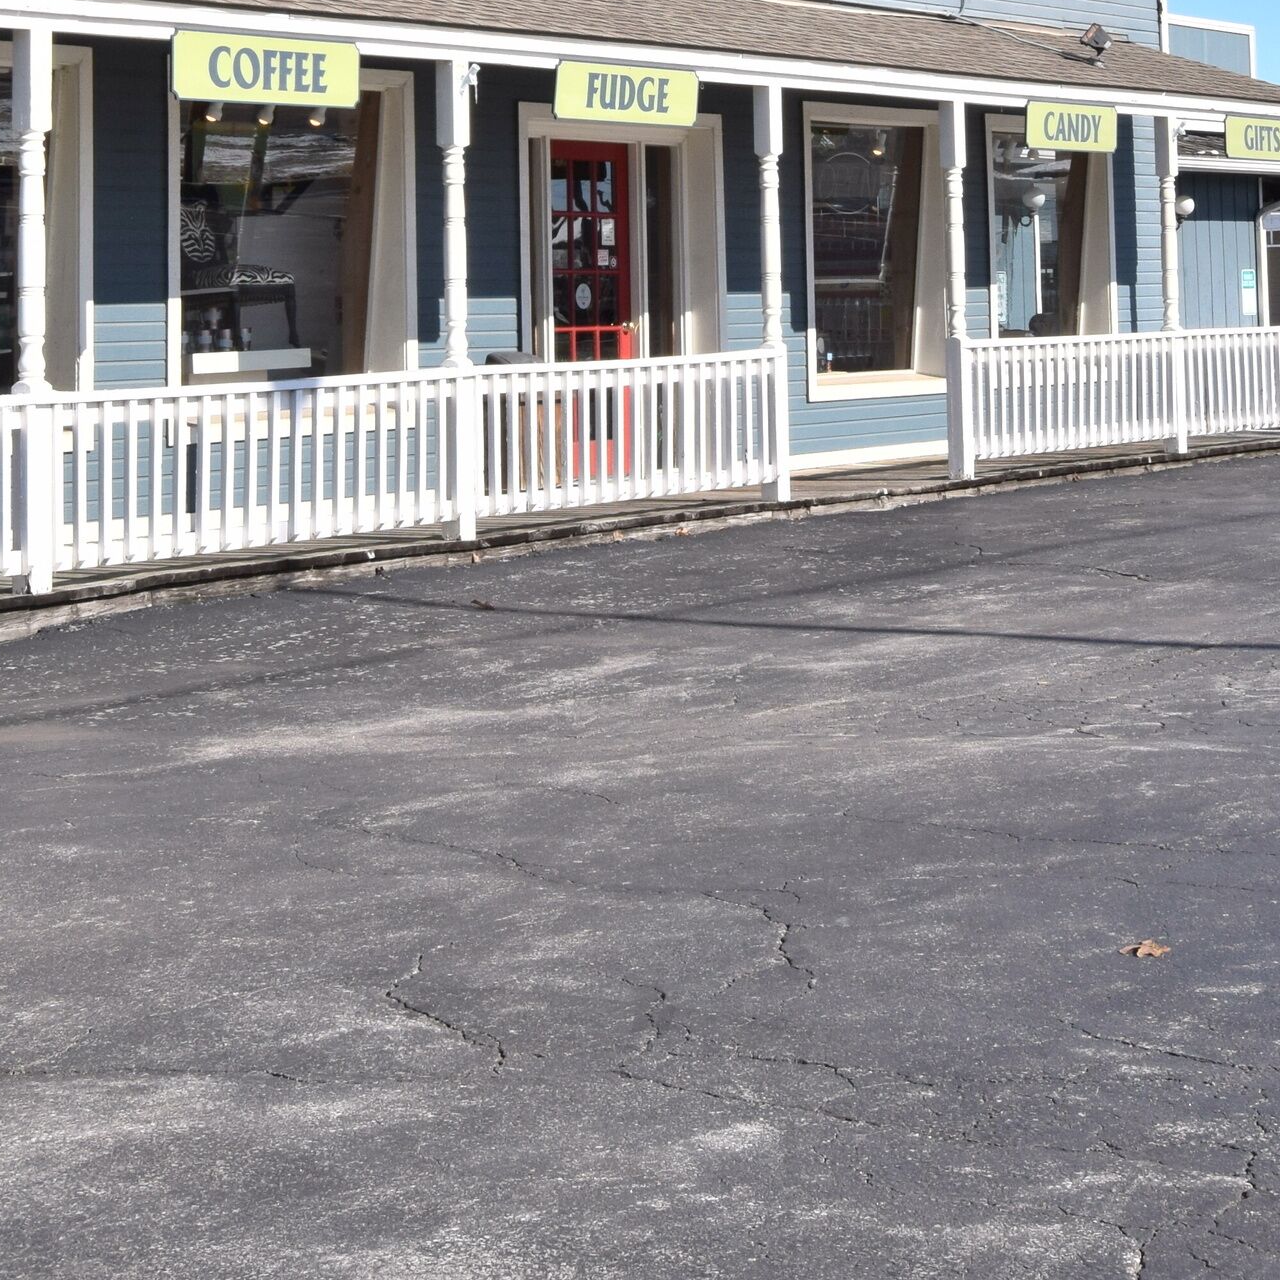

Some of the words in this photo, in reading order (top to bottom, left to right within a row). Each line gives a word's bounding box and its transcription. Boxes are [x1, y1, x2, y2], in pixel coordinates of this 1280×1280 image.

[207, 45, 329, 94] COFFEE
[584, 72, 671, 114] FUDGE
[1043, 111, 1102, 144] CANDY
[1244, 124, 1280, 153] GIFTS
